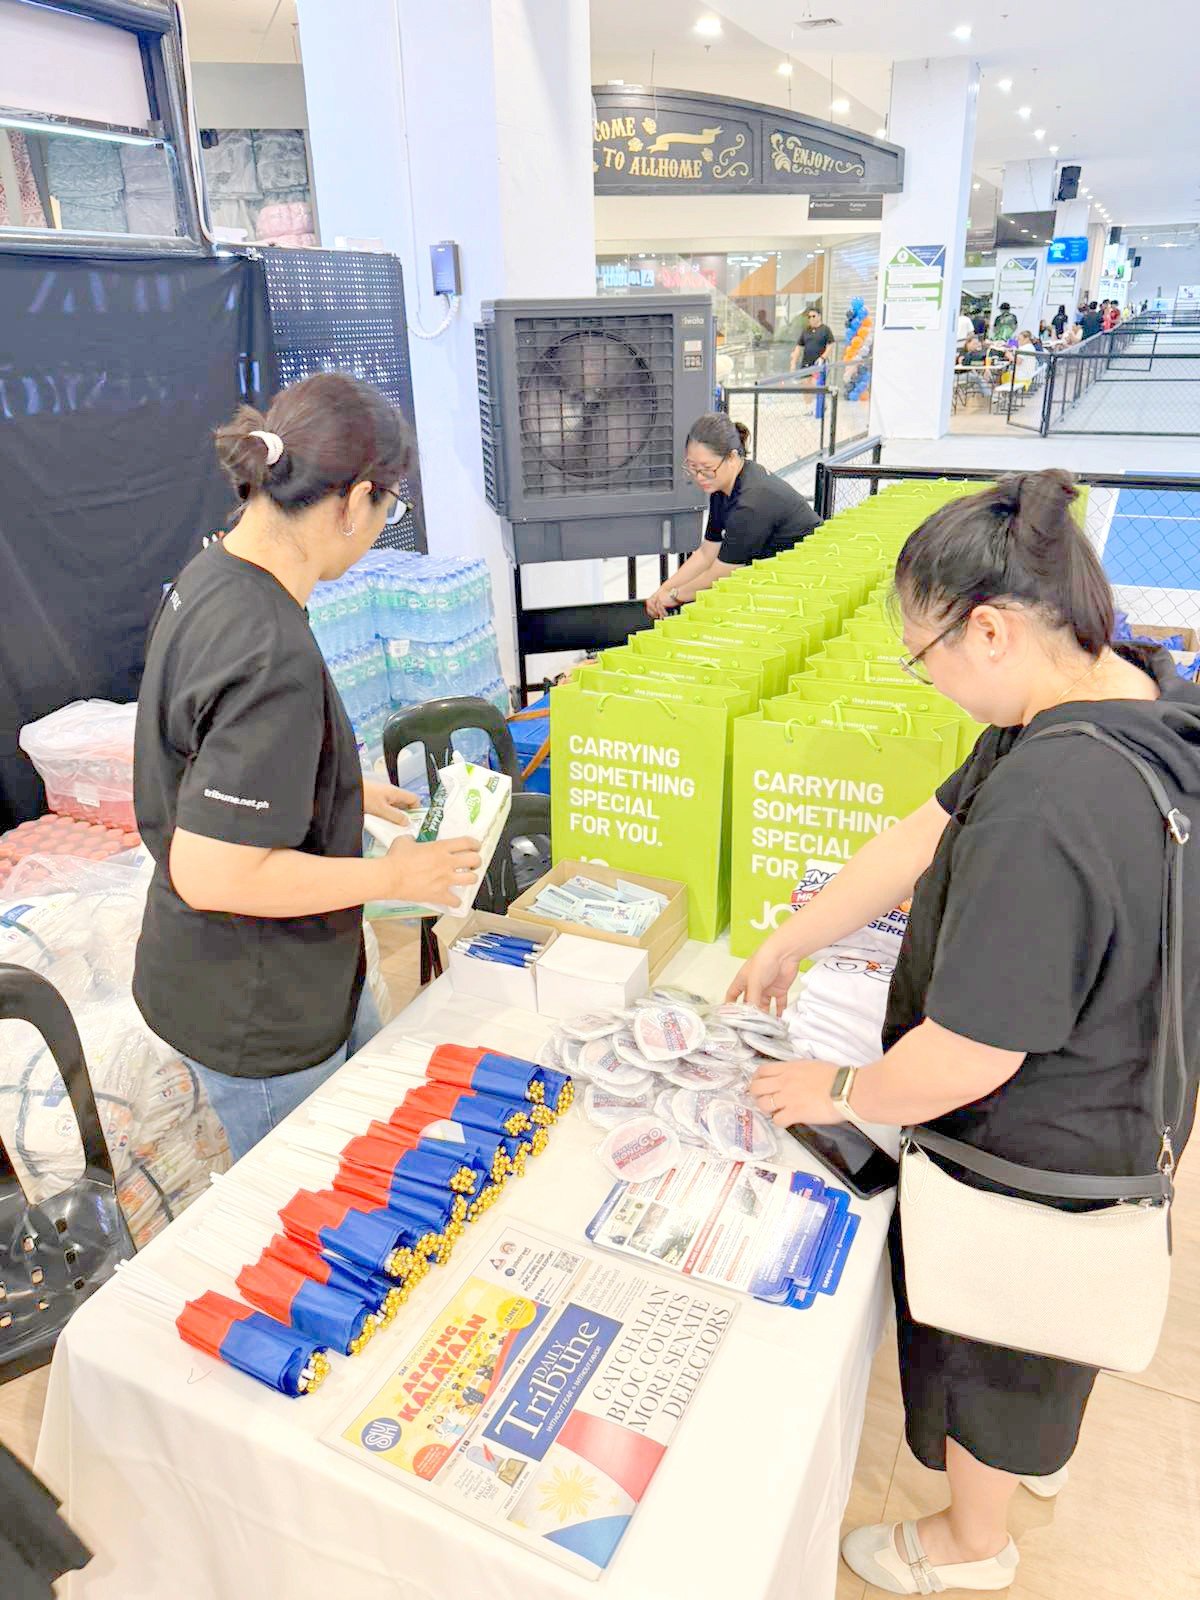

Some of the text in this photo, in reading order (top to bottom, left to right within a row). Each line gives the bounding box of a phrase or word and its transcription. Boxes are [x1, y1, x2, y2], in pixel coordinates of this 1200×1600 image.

[603, 147, 702, 179] TO ALLHOME
[792, 147, 834, 173] ENJOY!
[569, 734, 680, 768] CARRYING
[569, 761, 695, 798] SOMETHING
[753, 769, 884, 805] CARRYING
[204, 788, 270, 811] tribune.net.ph
[570, 787, 660, 820] SPECIAL
[570, 813, 663, 847] FOR YOU.
[752, 827, 854, 860] SPECIAL
[752, 854, 798, 880] FOR
[638, 1128, 663, 1148] GO
[504, 1299, 524, 1324] JUNE 12
[402, 1325, 458, 1395] ARAW NG
[534, 1340, 565, 1379] DAILY
[592, 1285, 669, 1400] GATCHALIAN
[606, 1367, 647, 1422] BLOC
[640, 1293, 689, 1365] COURTS
[398, 1313, 488, 1422] KALAYAAN
[494, 1322, 600, 1440] Tribune
[628, 1300, 710, 1432] MORE SENATE
[662, 1307, 730, 1420] DEFECTORS
[423, 1385, 444, 1412] TRABAHO
[441, 1371, 455, 1387] PARA
[546, 1345, 602, 1432] WITHOUT FEAR WITHOUT FAVOR
[365, 1421, 399, 1448] SM
